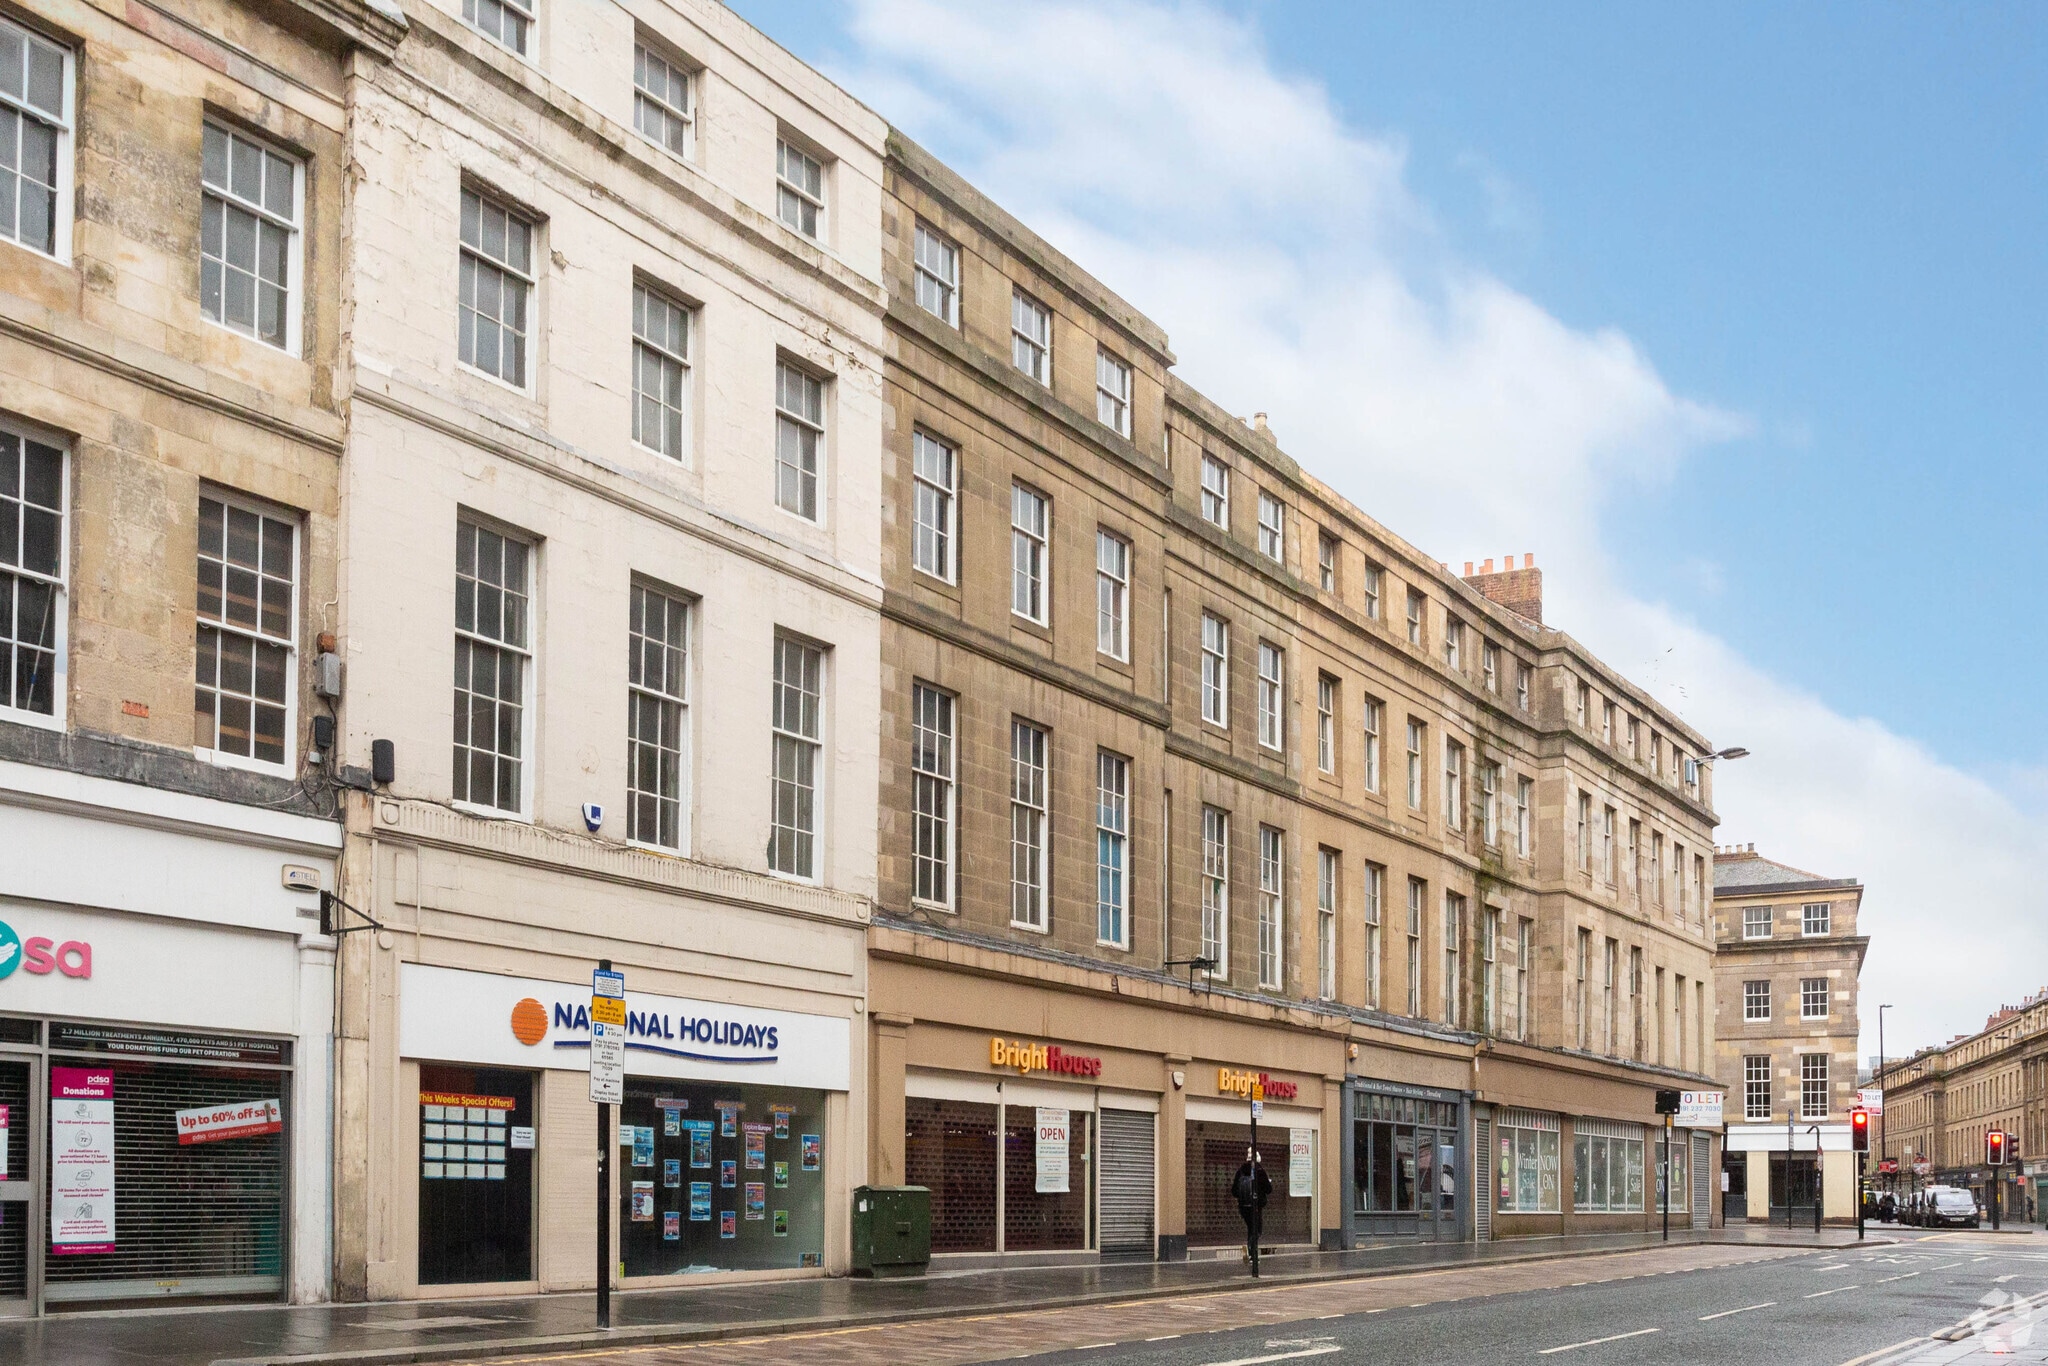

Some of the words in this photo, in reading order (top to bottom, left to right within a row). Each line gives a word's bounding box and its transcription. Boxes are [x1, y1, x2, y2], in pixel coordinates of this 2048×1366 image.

[554, 1001, 674, 1039] NANAL
[680, 1016, 779, 1050] HOLIDAYS
[74, 1029, 100, 1037] MILLION
[102, 1031, 141, 1040] TREATMENTS
[126, 1044, 161, 1052] DONATIONS
[990, 1037, 1102, 1076] BrightHouse
[88, 1075, 110, 1084] pdsa
[63, 1086, 104, 1096] Donations
[419, 1093, 433, 1102] This
[435, 1094, 460, 1104] Weeks
[461, 1096, 487, 1106] Special
[489, 1098, 513, 1108] Offers!
[1698, 1094, 1720, 1104] LET
[180, 1116, 196, 1128] Up
[198, 1115, 210, 1124] to
[212, 1111, 236, 1123] 60%
[237, 1108, 253, 1120] off
[1040, 1127, 1065, 1140] OPEN
[1293, 1144, 1309, 1154] OPEN
[1518, 1153, 1537, 1170] Winter
[1540, 1155, 1558, 1171] NOW
[1656, 1163, 1664, 1176] NO
[1522, 1172, 1535, 1189] Sale
[1543, 1174, 1554, 1190] ON
